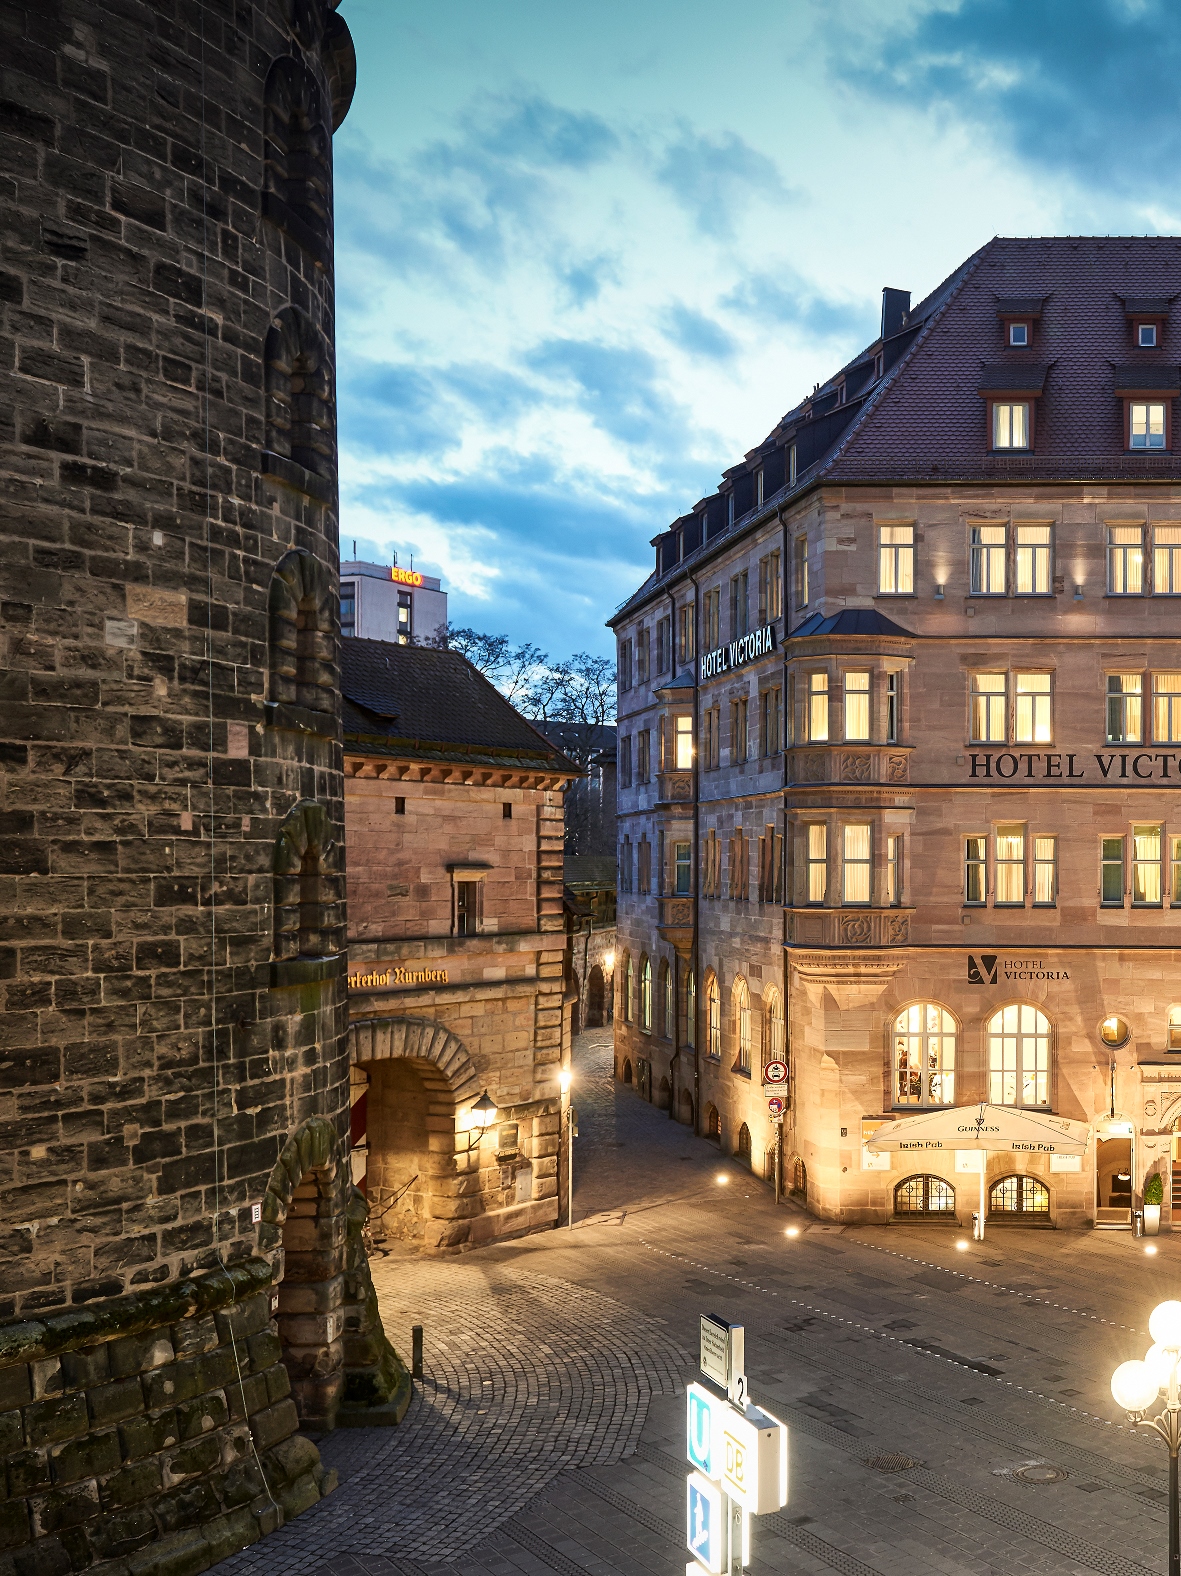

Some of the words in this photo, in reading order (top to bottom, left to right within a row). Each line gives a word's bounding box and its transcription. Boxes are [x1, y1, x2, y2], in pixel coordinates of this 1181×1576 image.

[391, 567, 422, 586] ERGO
[701, 647, 727, 680] HOTEL
[729, 625, 773, 669] VICTORIA
[968, 753, 1085, 779] HOTEL
[1004, 960, 1045, 969] HOTEL
[1004, 971, 1070, 980] VICTORIA
[957, 1125, 1000, 1133] GUINNESS
[925, 1141, 943, 1149] Pub
[1012, 1143, 1036, 1151] Irish
[1037, 1144, 1055, 1152] Pub
[737, 1377, 744, 1406] 2
[690, 1398, 709, 1461] U
[726, 1440, 744, 1483] DB
